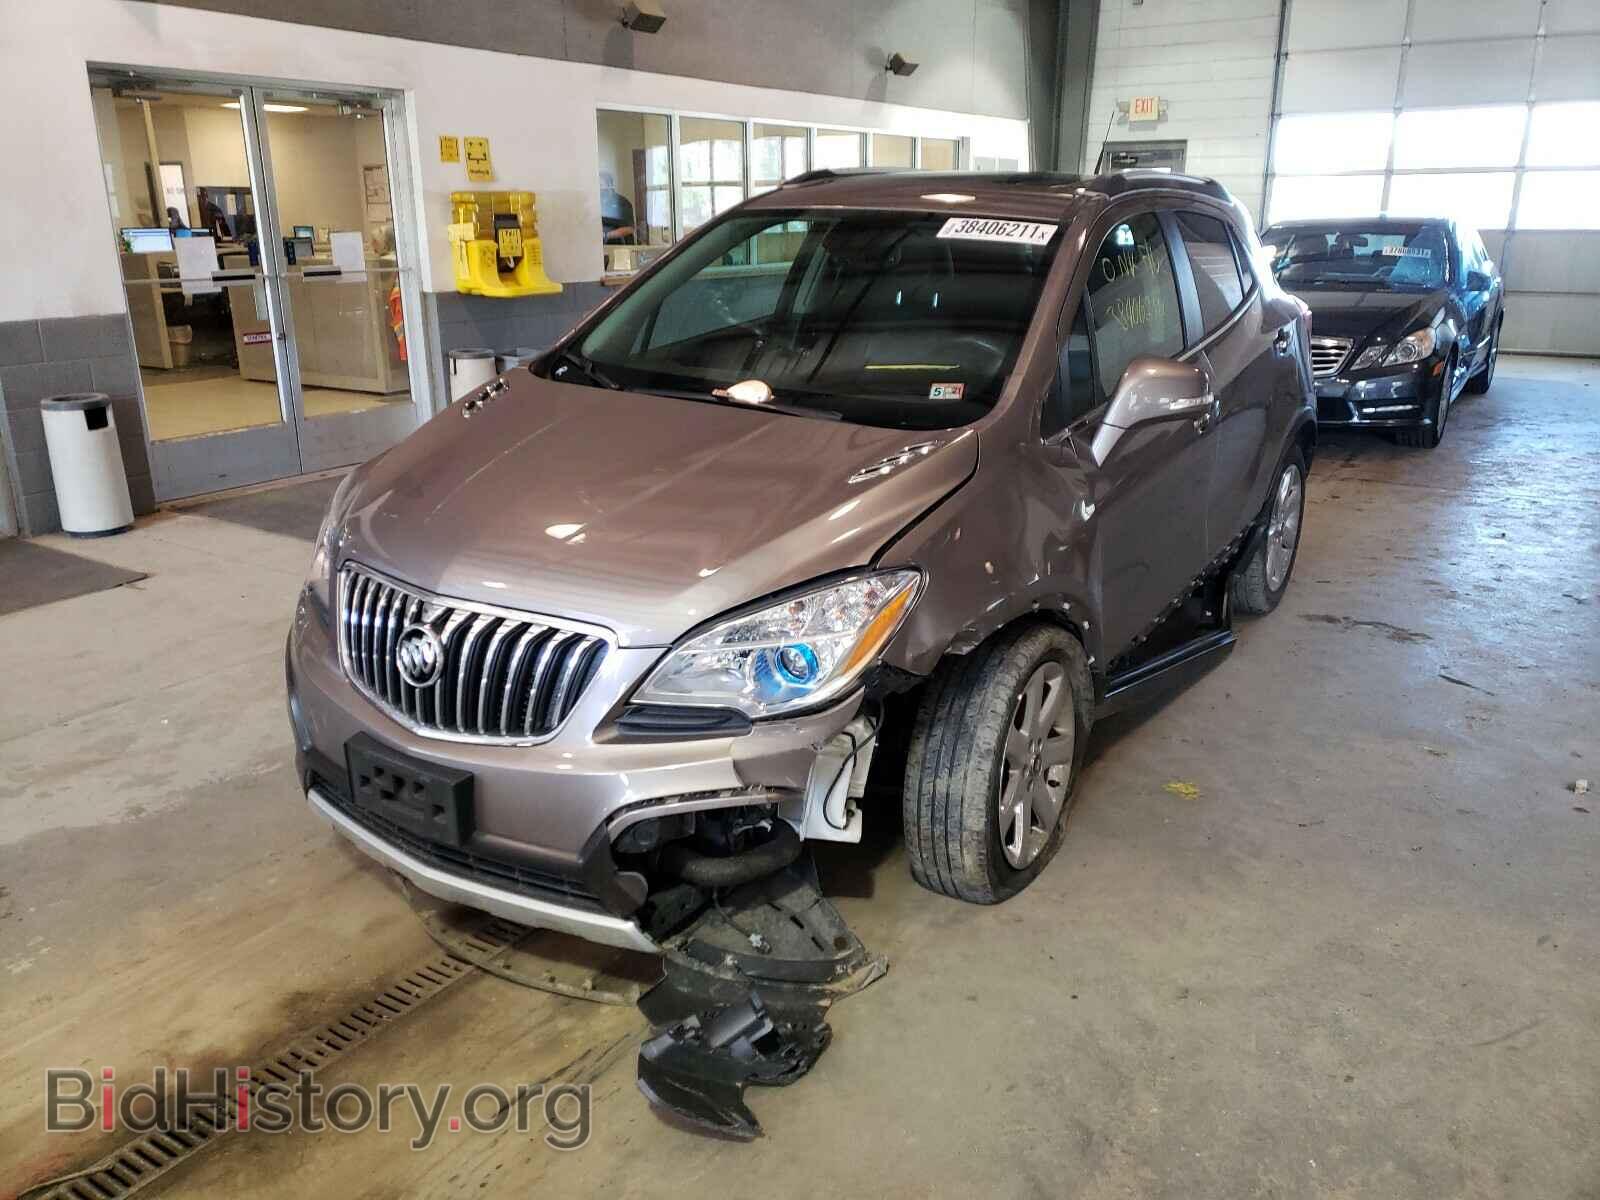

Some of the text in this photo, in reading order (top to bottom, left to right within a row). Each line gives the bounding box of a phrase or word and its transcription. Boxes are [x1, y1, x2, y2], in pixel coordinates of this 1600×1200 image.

[1135, 98, 1153, 113] EXIT
[954, 219, 1040, 239] 38406211
[932, 387, 944, 397] 5
